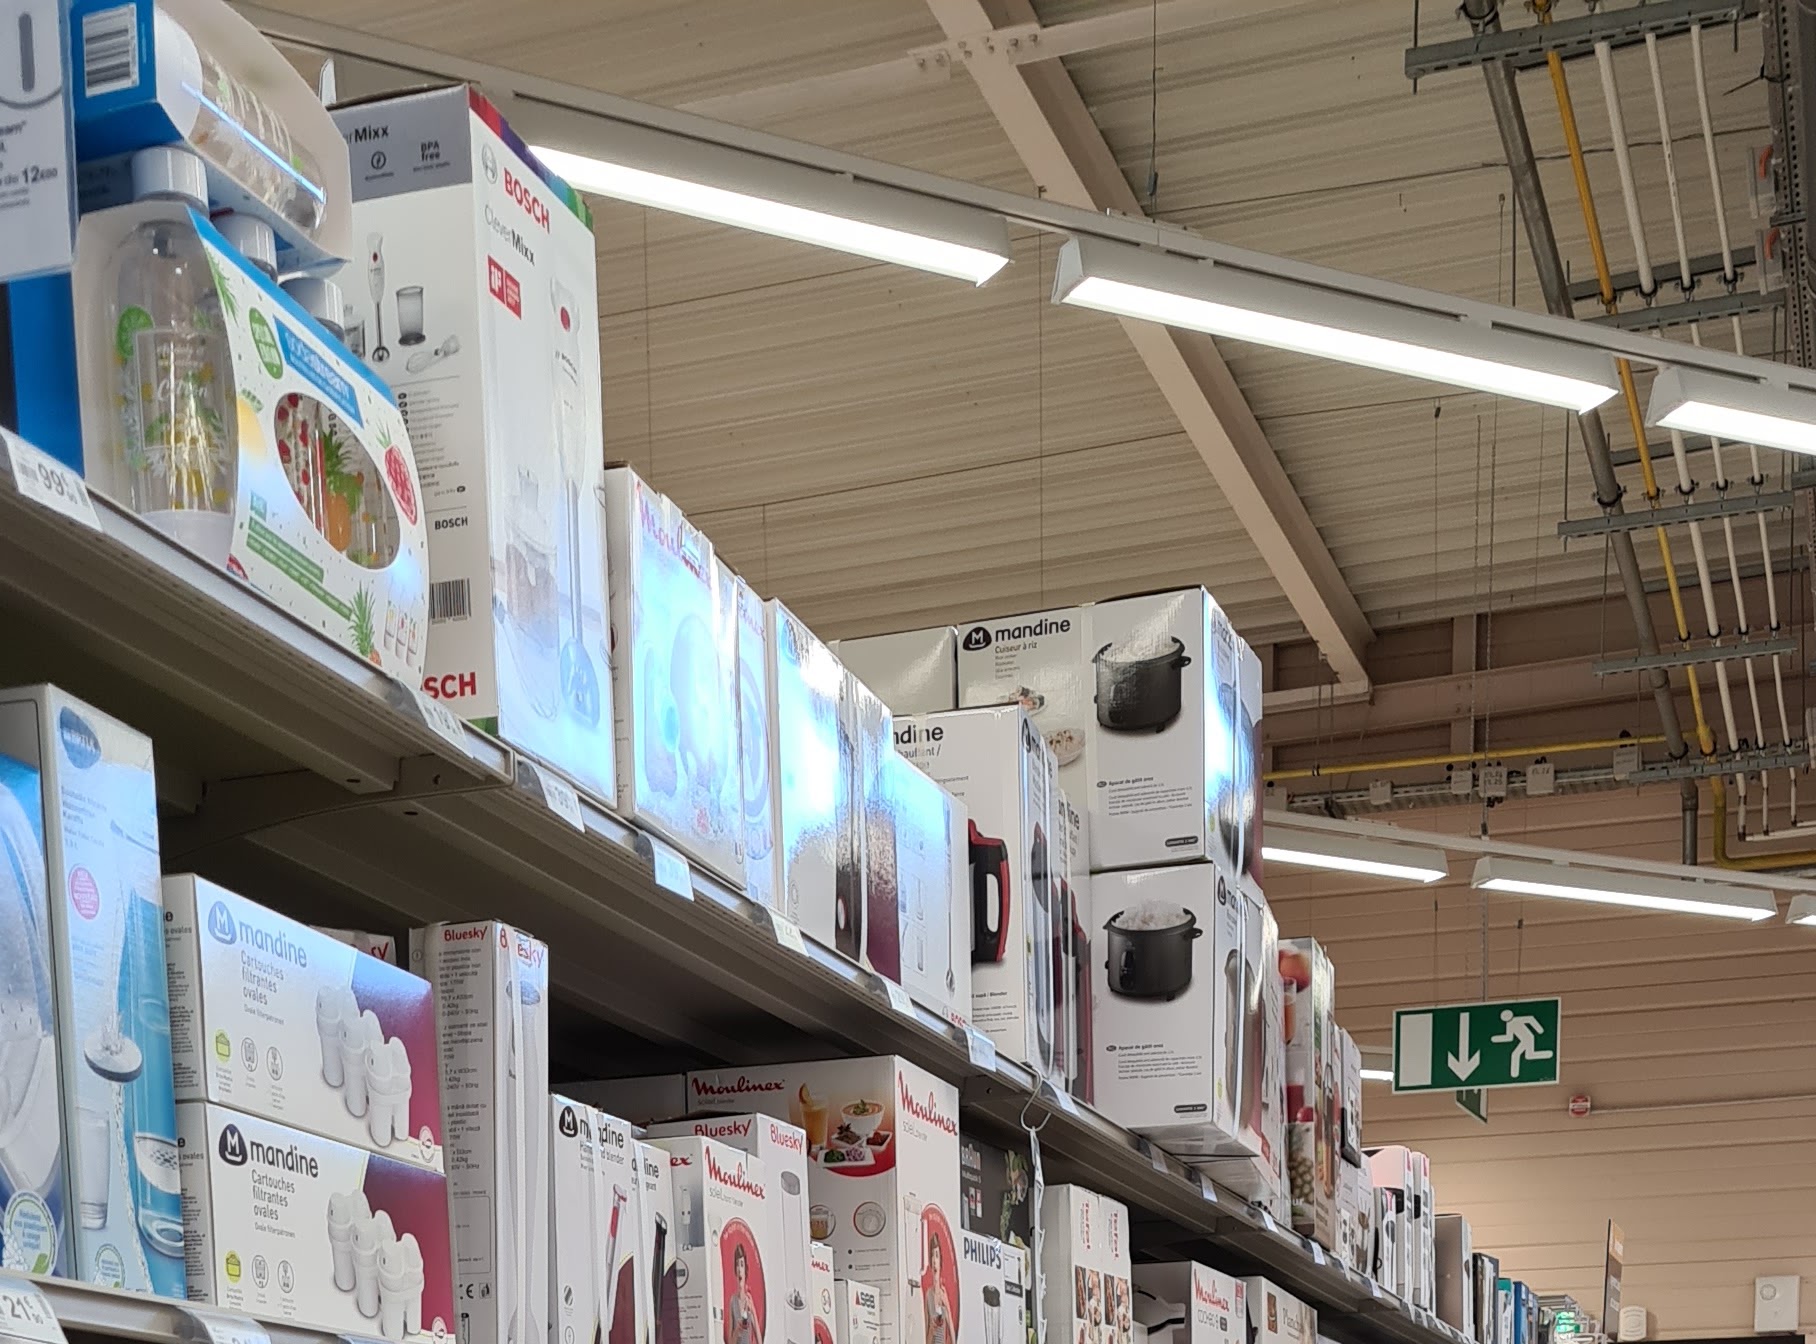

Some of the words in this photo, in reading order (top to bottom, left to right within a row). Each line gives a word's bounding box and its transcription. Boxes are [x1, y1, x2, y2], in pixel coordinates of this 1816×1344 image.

[503, 167, 551, 234] BOSCH
[484, 203, 536, 267] CleverMixx
[434, 516, 469, 531] BOSCH
[995, 617, 1071, 642] mandine
[995, 644, 1021, 654] Cuiseur
[421, 671, 477, 701] SCH
[239, 919, 308, 969] mandine
[444, 925, 488, 943] Bluesky
[240, 950, 284, 981] Cartouches
[241, 967, 278, 994] filtrantes
[243, 985, 268, 1006] ovales
[691, 1076, 784, 1098] Moulinex
[899, 1069, 958, 1137] Moulinex
[694, 1119, 752, 1136] Bluesky
[770, 1123, 805, 1155] Bluesky
[250, 1140, 319, 1179] mandine
[705, 1145, 766, 1200] Moulinex
[251, 1169, 296, 1194] Cartouches
[252, 1186, 289, 1208] filtrantes
[254, 1204, 279, 1221] ovales
[963, 1236, 1001, 1269] PHILIPS
